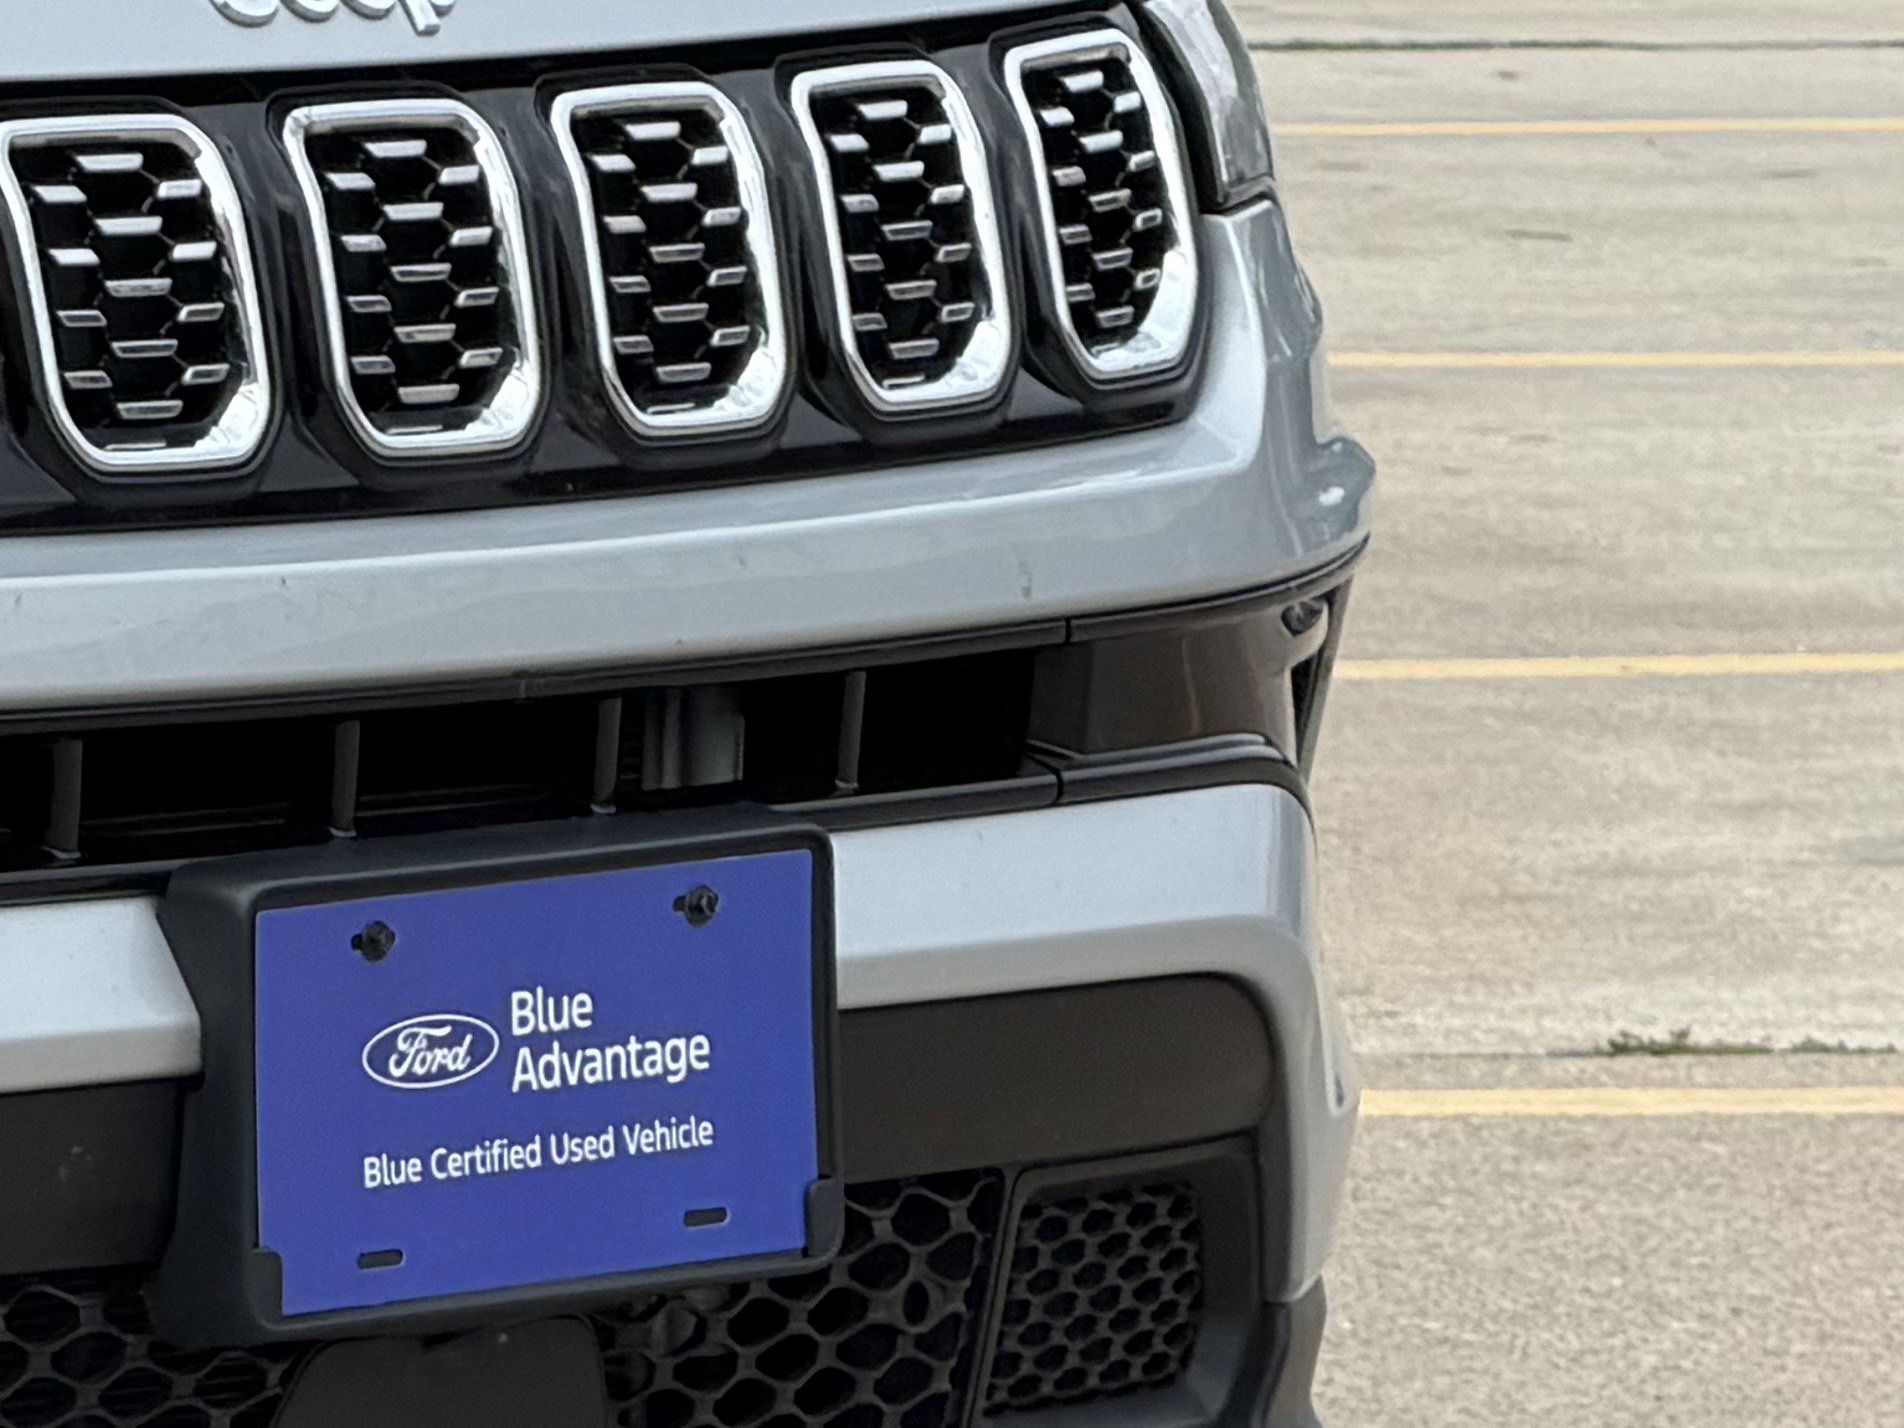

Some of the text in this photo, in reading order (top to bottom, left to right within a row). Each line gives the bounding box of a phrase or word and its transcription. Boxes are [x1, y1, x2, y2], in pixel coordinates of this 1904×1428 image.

[510, 986, 593, 1036] Blue
[388, 1025, 473, 1078] Ford
[511, 1032, 710, 1093] Advantage
[363, 1115, 714, 1189] Blue Certified Used Vehicle
